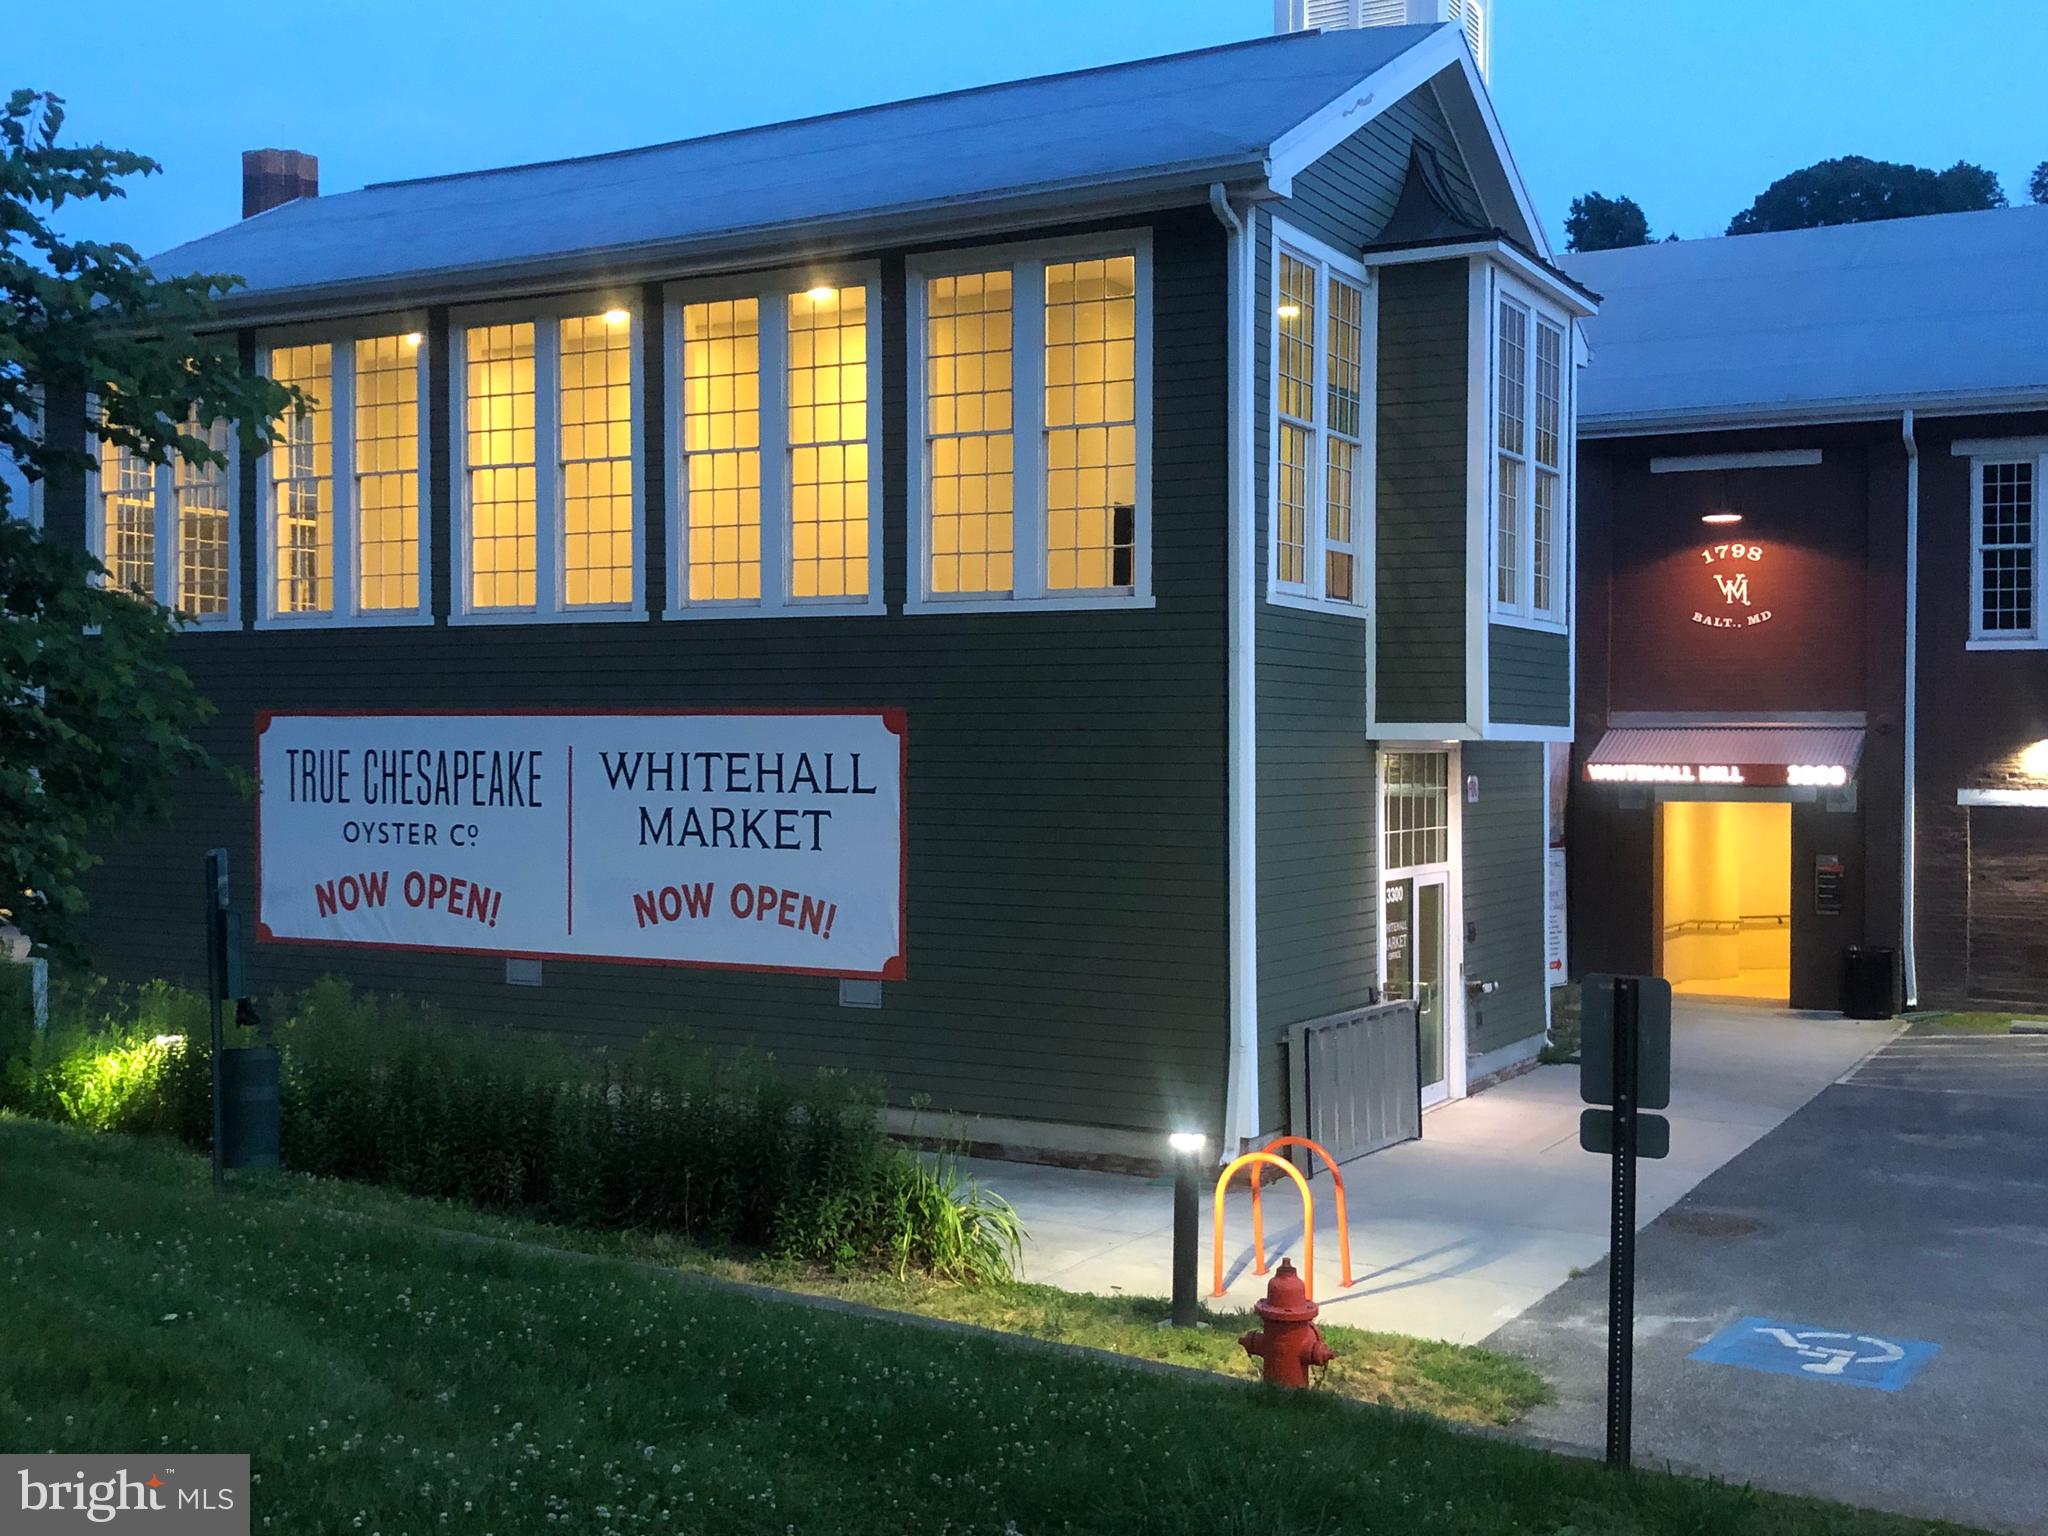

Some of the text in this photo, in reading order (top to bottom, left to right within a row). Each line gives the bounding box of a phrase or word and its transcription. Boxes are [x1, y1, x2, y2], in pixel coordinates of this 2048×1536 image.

[1701, 543, 1763, 565] 1798
[1747, 610, 1772, 626] MD
[286, 748, 543, 807] TRUE CHESAPEAKE
[599, 751, 877, 795] WHITEHALL
[343, 821, 437, 846] OYSTER
[638, 806, 832, 852] MARKET
[314, 870, 503, 928] NOW OPEN!
[632, 882, 838, 940] NOW OPEN!
[1386, 886, 1403, 903] 3300
